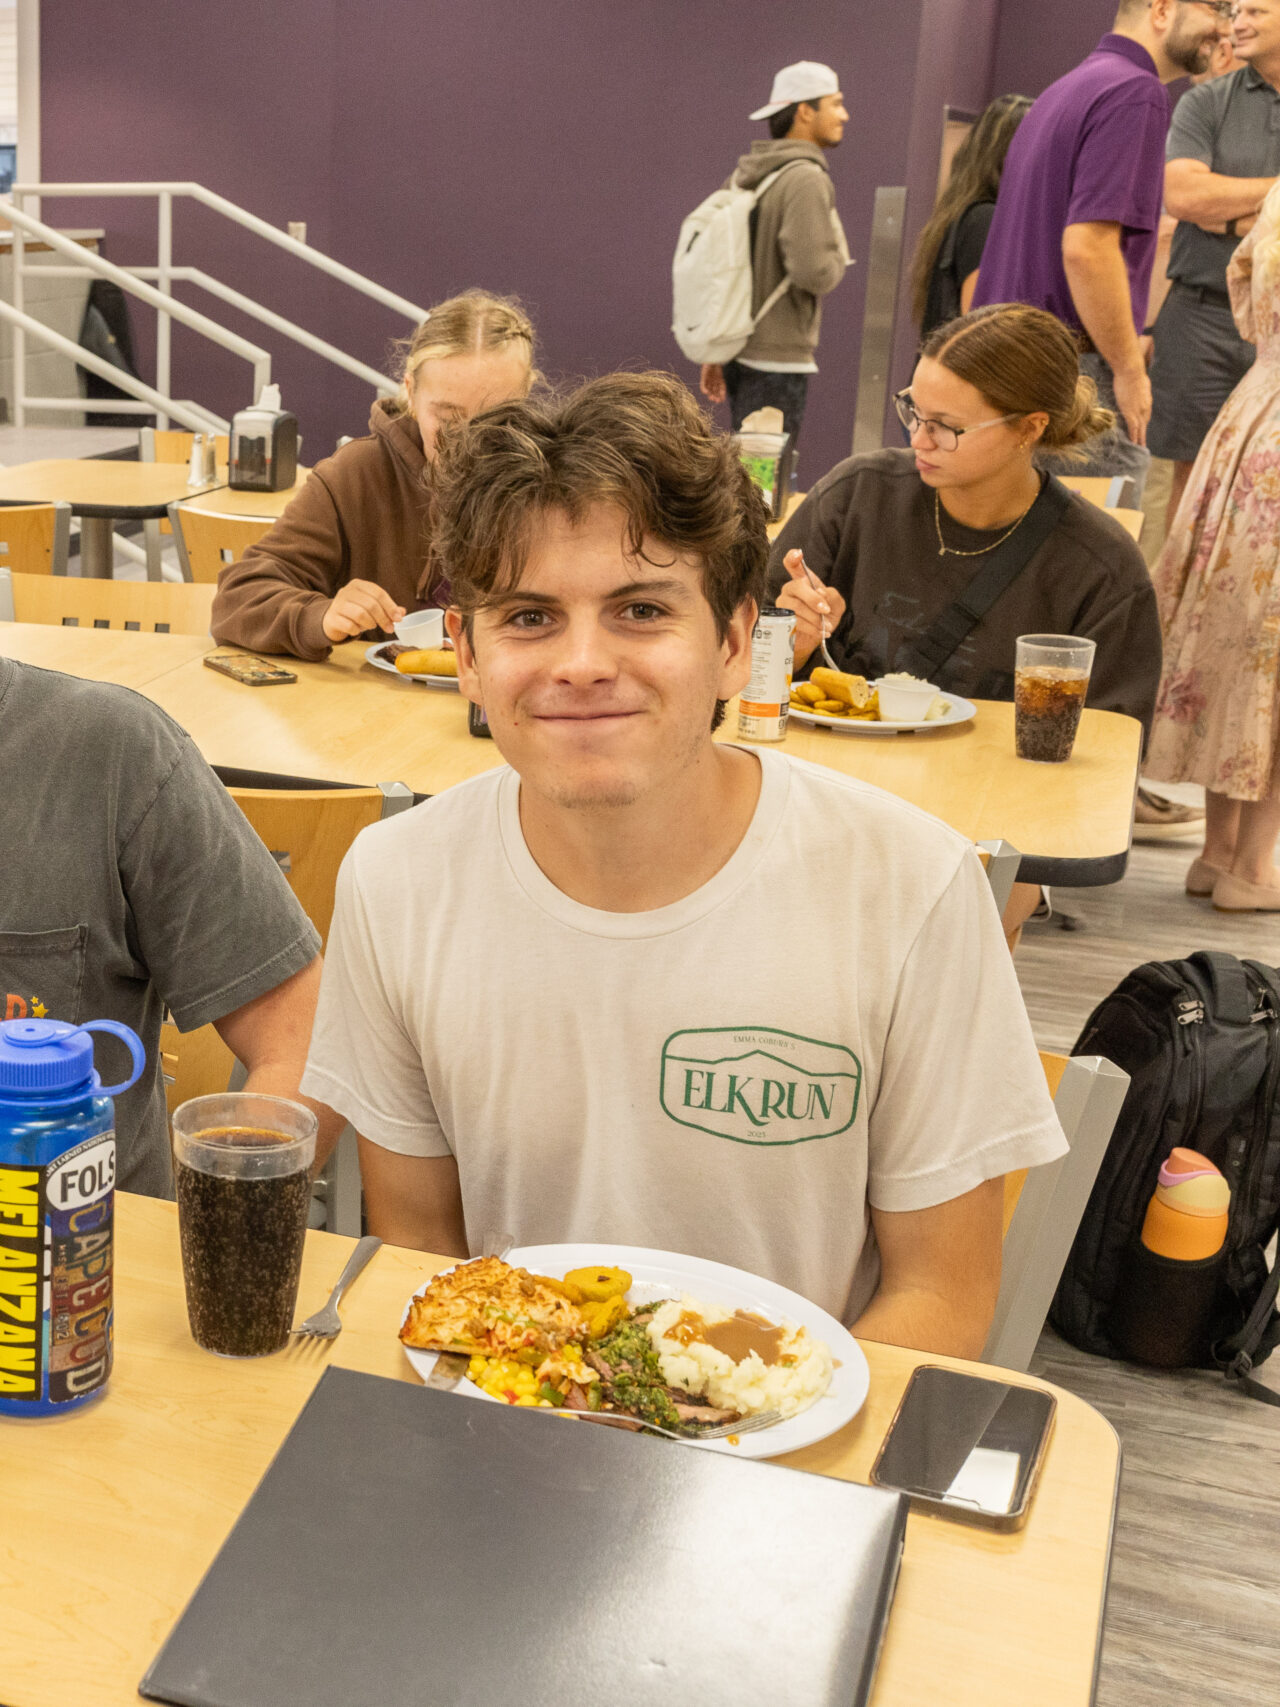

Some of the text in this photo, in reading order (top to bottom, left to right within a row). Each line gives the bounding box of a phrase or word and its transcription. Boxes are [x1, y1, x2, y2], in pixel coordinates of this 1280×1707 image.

[682, 1068, 837, 1127] ELK RUN
[59, 1149, 115, 1204] FOLS
